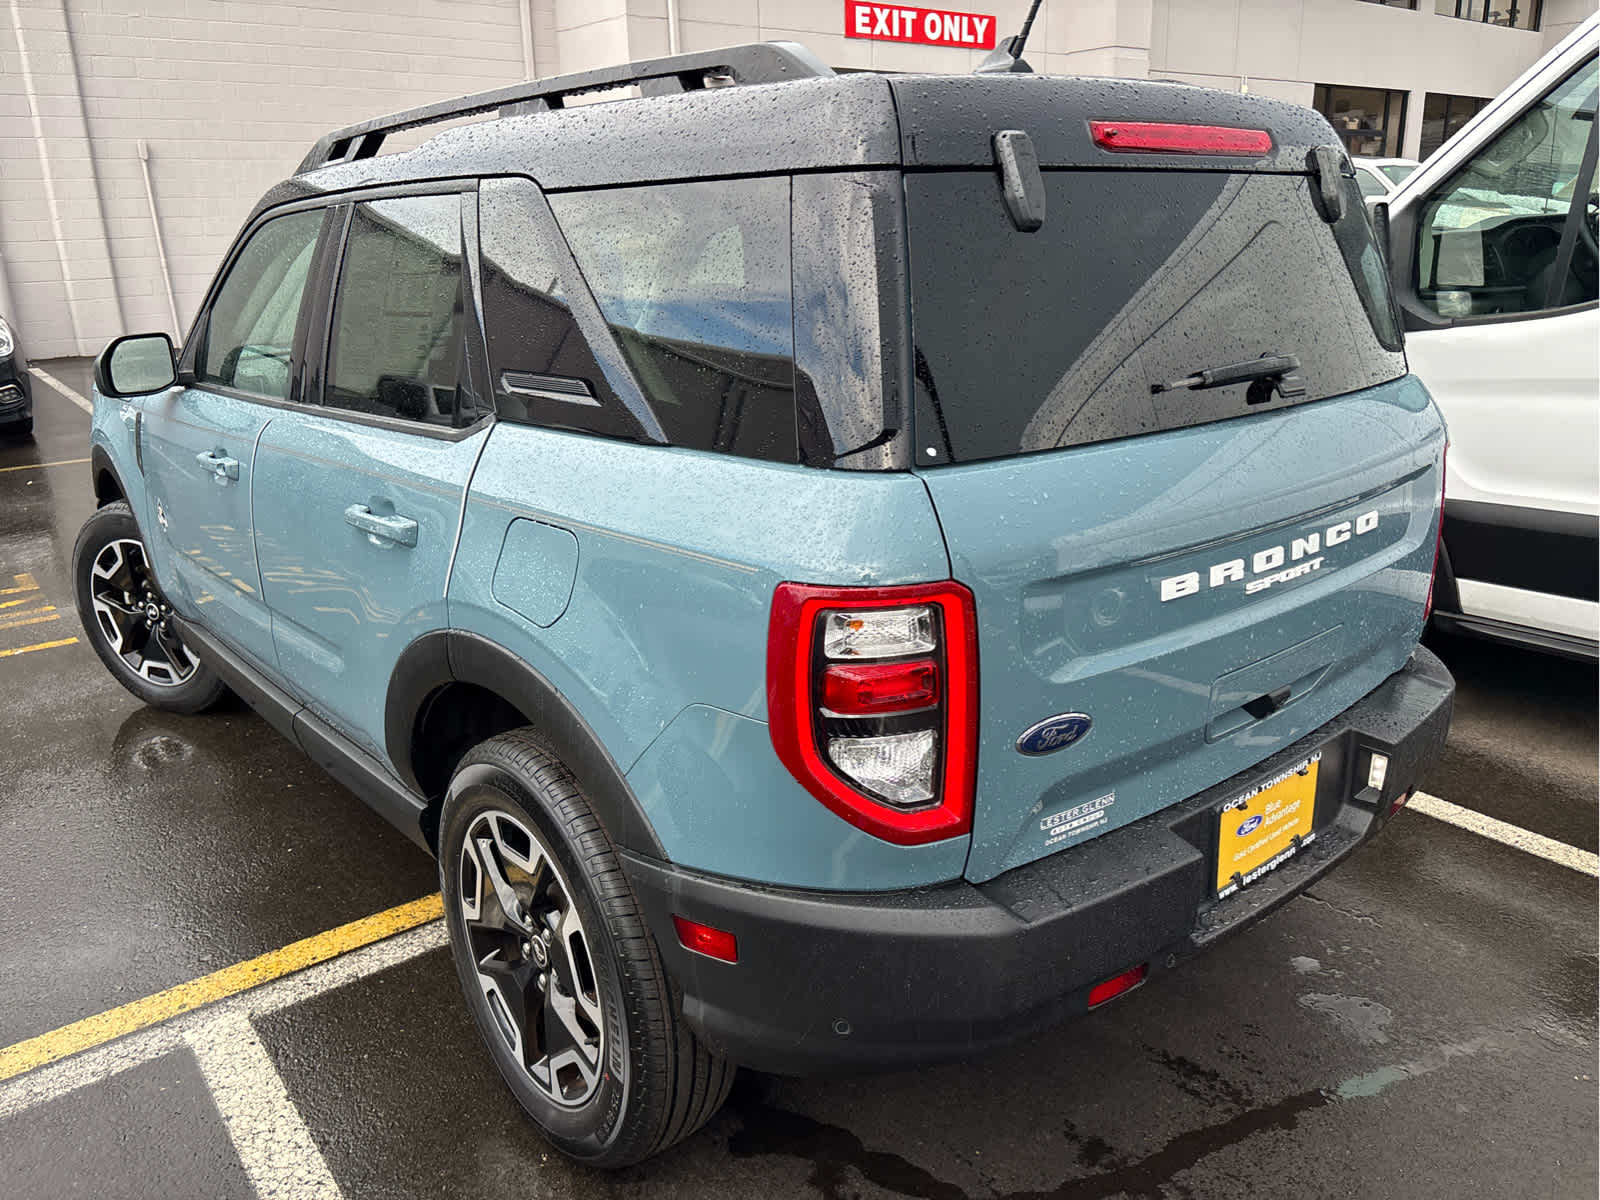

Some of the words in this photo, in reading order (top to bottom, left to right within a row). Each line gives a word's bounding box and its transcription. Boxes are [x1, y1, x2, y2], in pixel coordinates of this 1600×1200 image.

[855, 5, 917, 38] EXIT
[924, 12, 989, 44] ONLY
[1160, 510, 1379, 602] BRONCO
[1245, 556, 1325, 595] SPORT
[1037, 723, 1078, 750] Ford
[1223, 788, 1259, 813] OCEAN
[1261, 760, 1309, 793] TOWNSHIP
[1311, 751, 1322, 764] NJ
[1040, 806, 1080, 829] LESTER
[1081, 793, 1116, 814] GLENN
[1239, 816, 1260, 835] Ford
[1264, 799, 1301, 826] Advantage
[1265, 799, 1282, 815] Blue
[1242, 846, 1297, 886] lesterglenn
